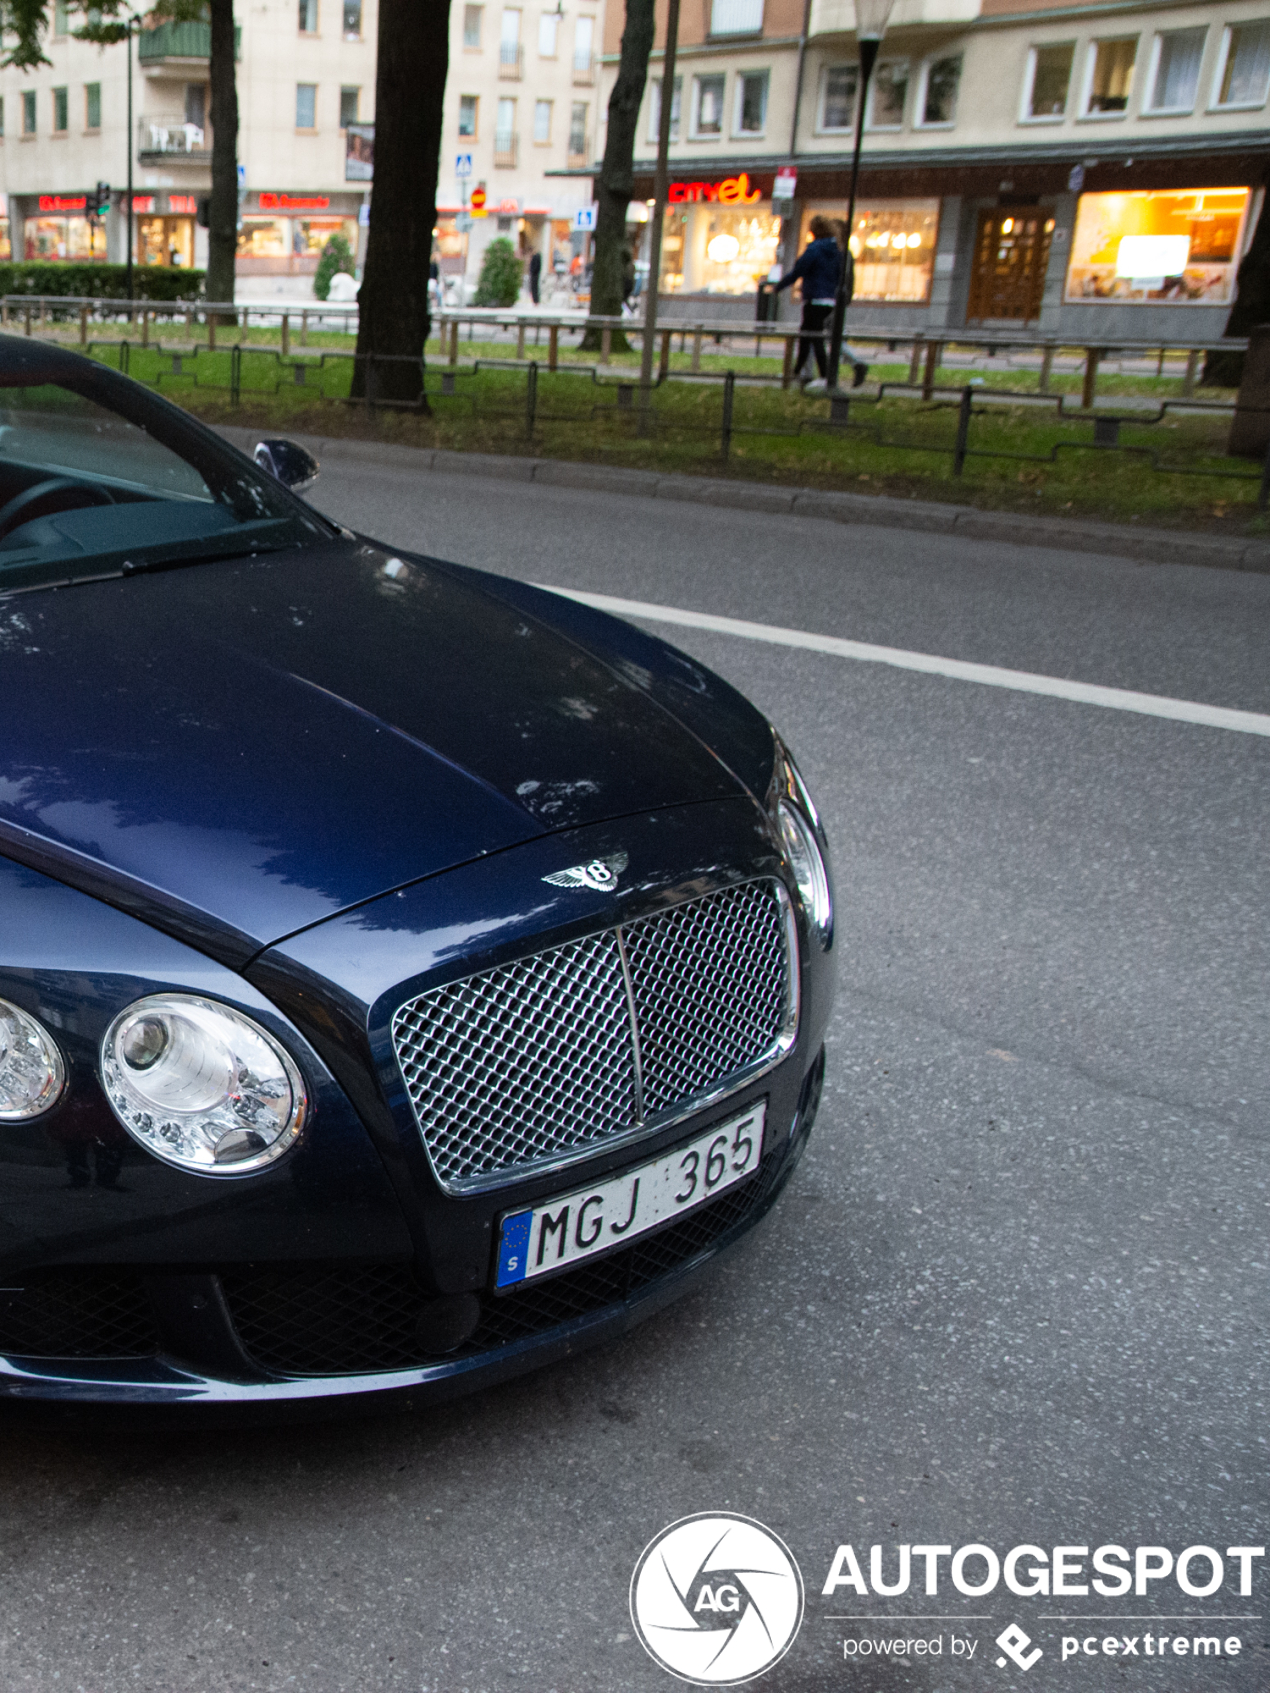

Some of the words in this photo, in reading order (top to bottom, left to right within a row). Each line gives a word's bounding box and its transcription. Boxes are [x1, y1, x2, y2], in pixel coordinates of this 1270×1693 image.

[535, 1176, 641, 1267] MGJ
[674, 1116, 755, 1204] 365
[507, 1255, 519, 1272] S
